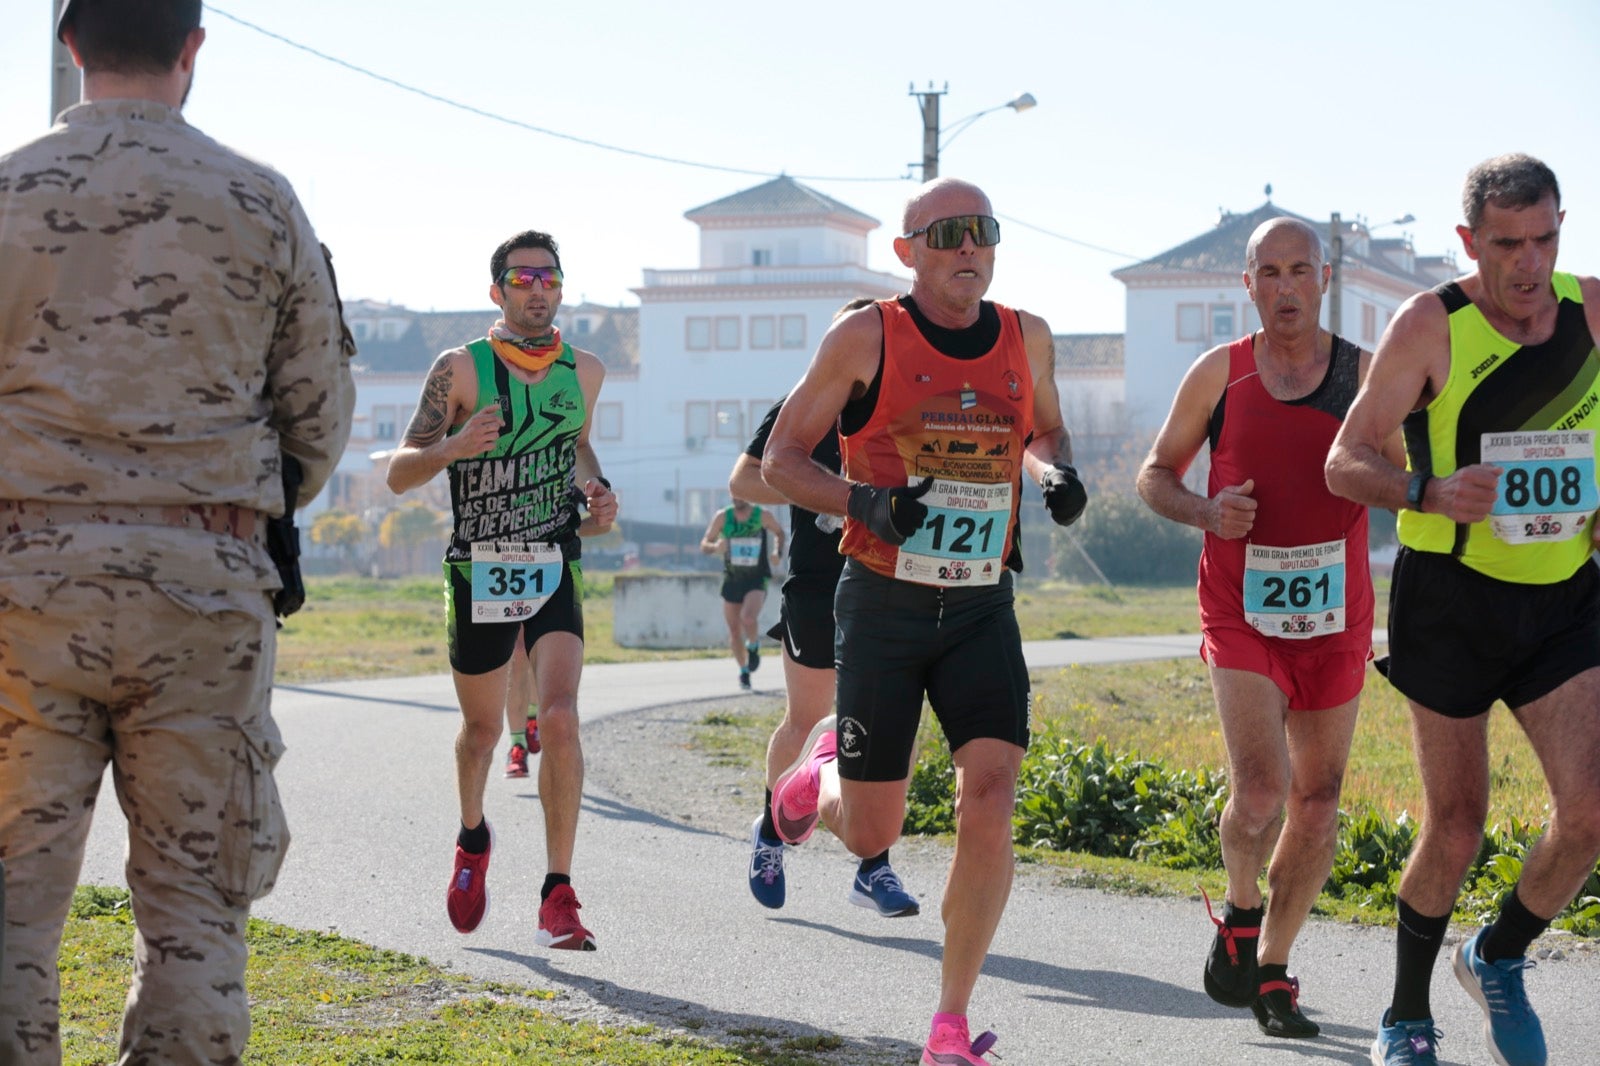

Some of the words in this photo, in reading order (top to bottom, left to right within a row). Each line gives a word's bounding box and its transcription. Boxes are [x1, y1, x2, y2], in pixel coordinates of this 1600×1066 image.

[1470, 353, 1499, 380] Joma
[921, 411, 1015, 424] PERSIALGLASS
[967, 425, 990, 433] Vidrio
[1513, 435, 1532, 446] GRAN
[1534, 434, 1560, 446] PREMIO
[1561, 434, 1569, 445] DE
[457, 460, 515, 501] TEAM
[938, 484, 958, 496] GRAN
[960, 486, 986, 499] PREMIO
[986, 488, 993, 499] DE
[1505, 466, 1581, 507] 808
[486, 495, 508, 512] DE
[458, 518, 476, 541] UE
[477, 513, 500, 536] DE
[500, 499, 559, 533] PIERNAS
[925, 513, 994, 553] 121
[510, 545, 533, 553] PREMO
[533, 545, 539, 553] DE
[1252, 548, 1270, 558] XXXIII
[1271, 550, 1290, 560] GRAN
[1290, 548, 1315, 559] PREMIO
[1315, 547, 1323, 557] DE
[488, 567, 543, 596] 351
[1262, 572, 1329, 608] 261
